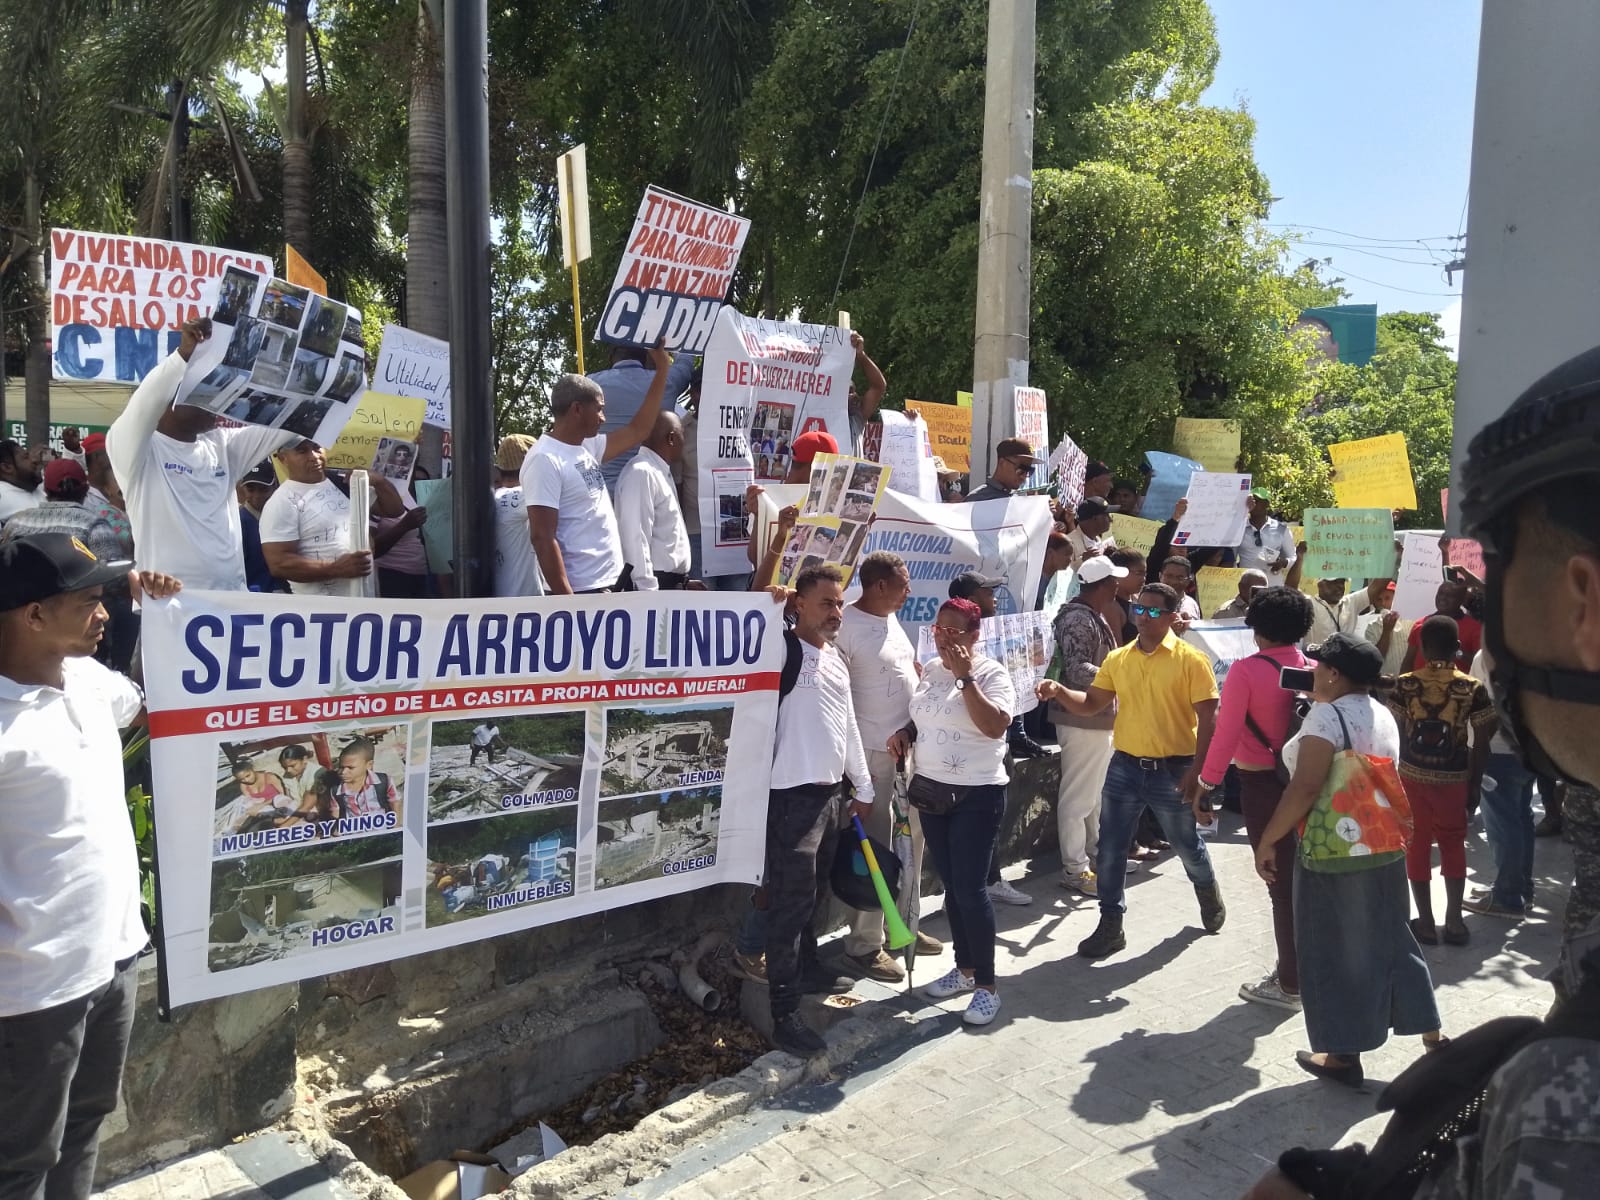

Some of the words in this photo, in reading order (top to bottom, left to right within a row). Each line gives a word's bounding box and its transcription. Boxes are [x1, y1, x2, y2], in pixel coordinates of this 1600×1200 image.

[644, 193, 741, 246] TITULACION
[51, 230, 187, 274] VIVIENDA
[628, 224, 678, 263] PARA
[59, 262, 136, 297] PARA
[148, 272, 206, 301] LOS
[54, 293, 211, 331] DESALOJA
[604, 290, 721, 352] CNDH
[385, 353, 442, 393] Utilidad
[726, 360, 749, 386] DE
[760, 366, 793, 391] FUERZA
[793, 370, 832, 397] AEREA
[879, 530, 953, 555] NACIONAL
[181, 612, 422, 695] SECTOR
[436, 609, 632, 678] ARROYO
[644, 608, 767, 668] LINDO
[205, 707, 260, 729] QUE
[268, 705, 298, 722] EL
[306, 696, 386, 720] SUEÑO
[394, 695, 423, 711] DE
[430, 693, 457, 709] LA
[463, 688, 536, 707] CASITA
[541, 684, 609, 702] PROPIA
[614, 681, 678, 697] NUNCA
[683, 678, 746, 694] MUERA!!
[678, 770, 724, 786] TIENDA
[501, 788, 575, 810] COLMADO
[220, 824, 315, 852] MUJERES
[320, 821, 337, 838] Y
[339, 811, 397, 835] NIÑOS
[662, 854, 716, 875] COLEGIO
[487, 880, 572, 911] INMUEBLES
[311, 916, 394, 947] HOGAR
